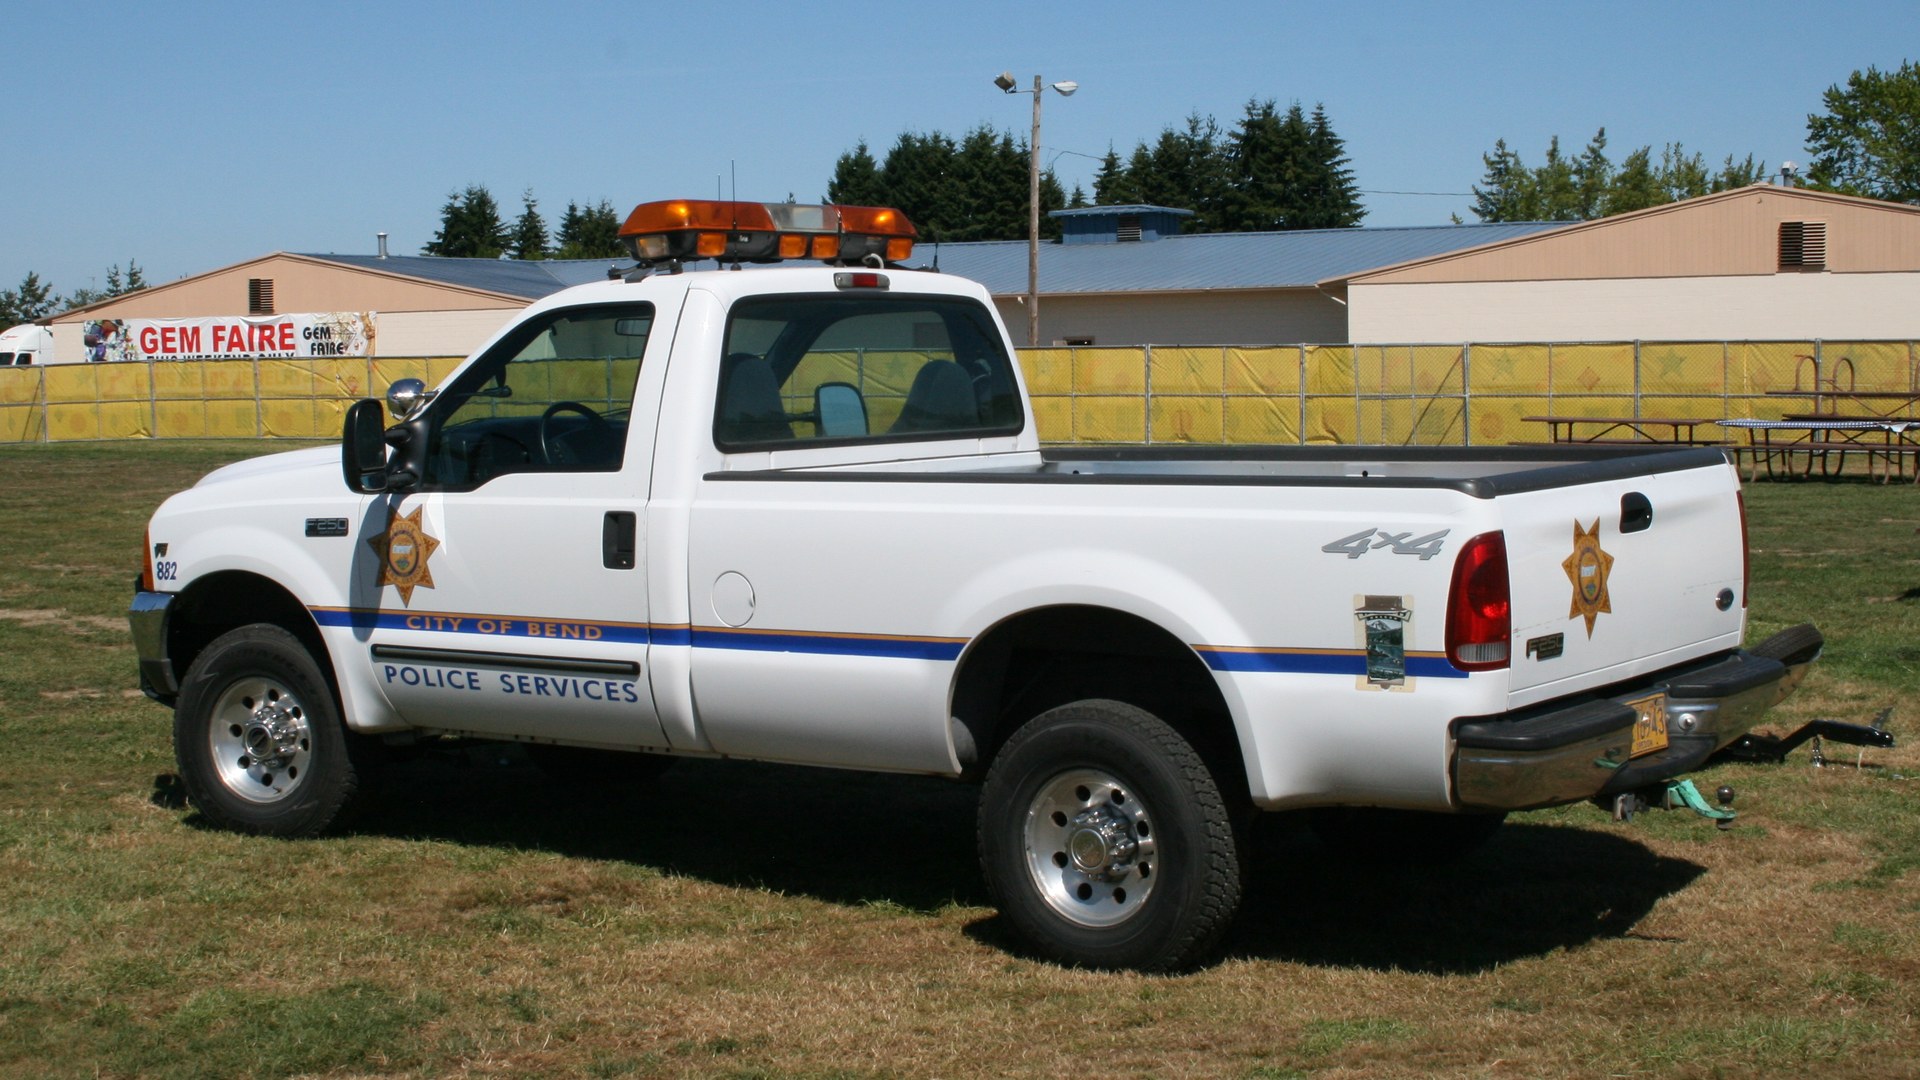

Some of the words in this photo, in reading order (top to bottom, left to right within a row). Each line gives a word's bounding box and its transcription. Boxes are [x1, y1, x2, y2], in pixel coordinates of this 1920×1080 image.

[139, 326, 201, 355] GEM
[212, 322, 296, 353] FAIRE
[302, 326, 332, 341] GEM
[310, 341, 345, 356] FAIRE
[1321, 527, 1451, 561] 4x4
[156, 561, 177, 581] 882
[405, 616, 462, 632] CITY
[477, 619, 512, 634] OF
[527, 622, 602, 640] BEND
[384, 665, 482, 691] POLICE
[499, 674, 639, 703] SERVICES
